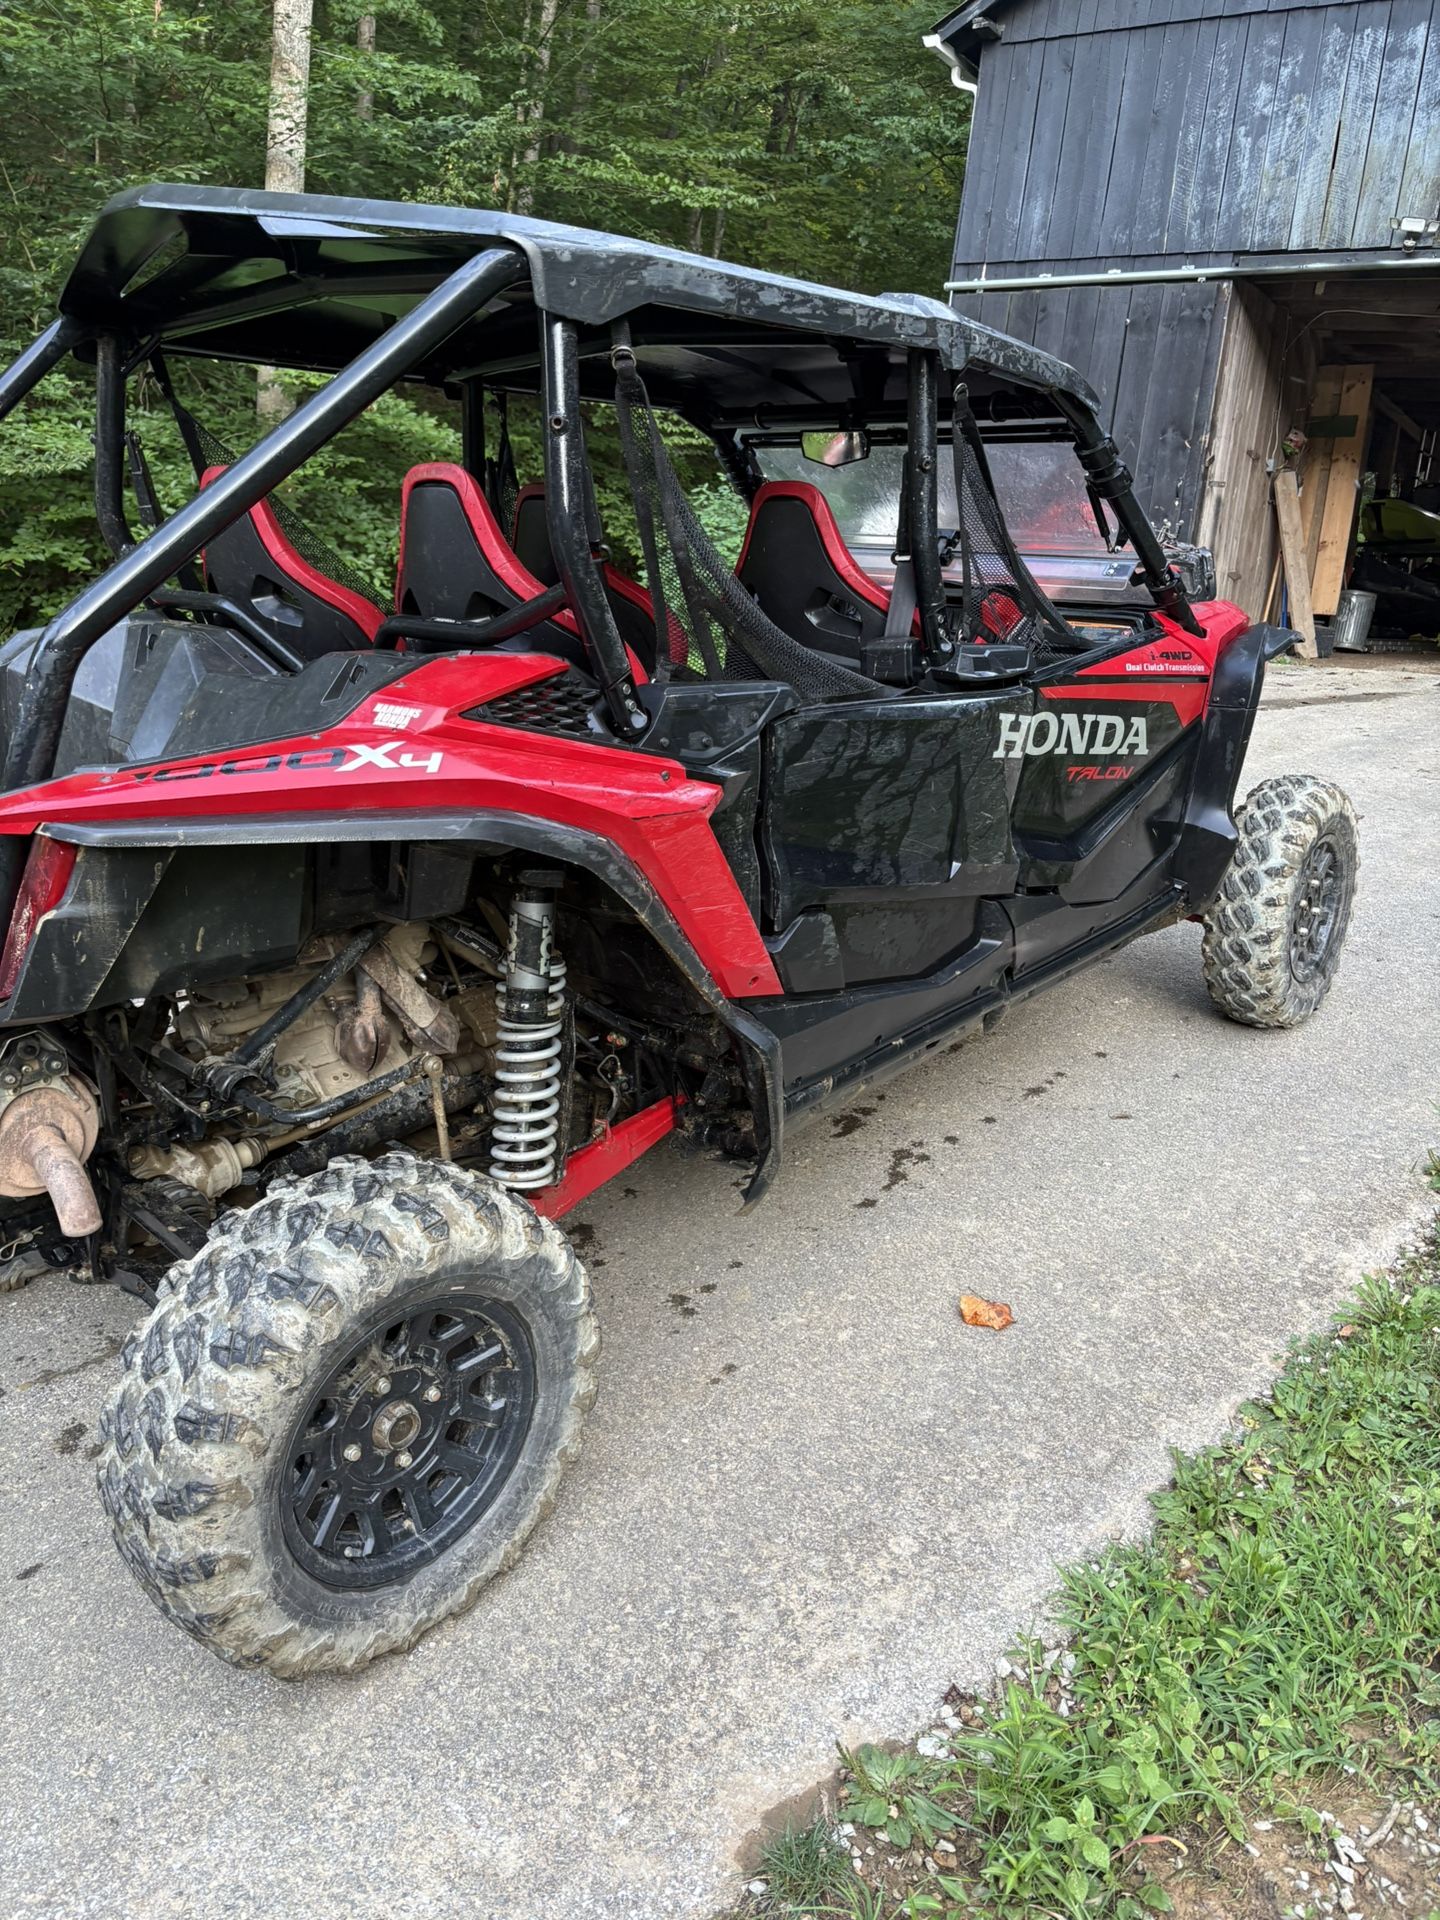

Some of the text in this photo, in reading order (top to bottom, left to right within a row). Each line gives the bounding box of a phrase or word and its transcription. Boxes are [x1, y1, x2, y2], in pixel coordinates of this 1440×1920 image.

[1125, 663, 1204, 672] Dual Clutch Transmission
[992, 711, 1149, 758] HONDA
[1066, 766, 1134, 782] TALON
